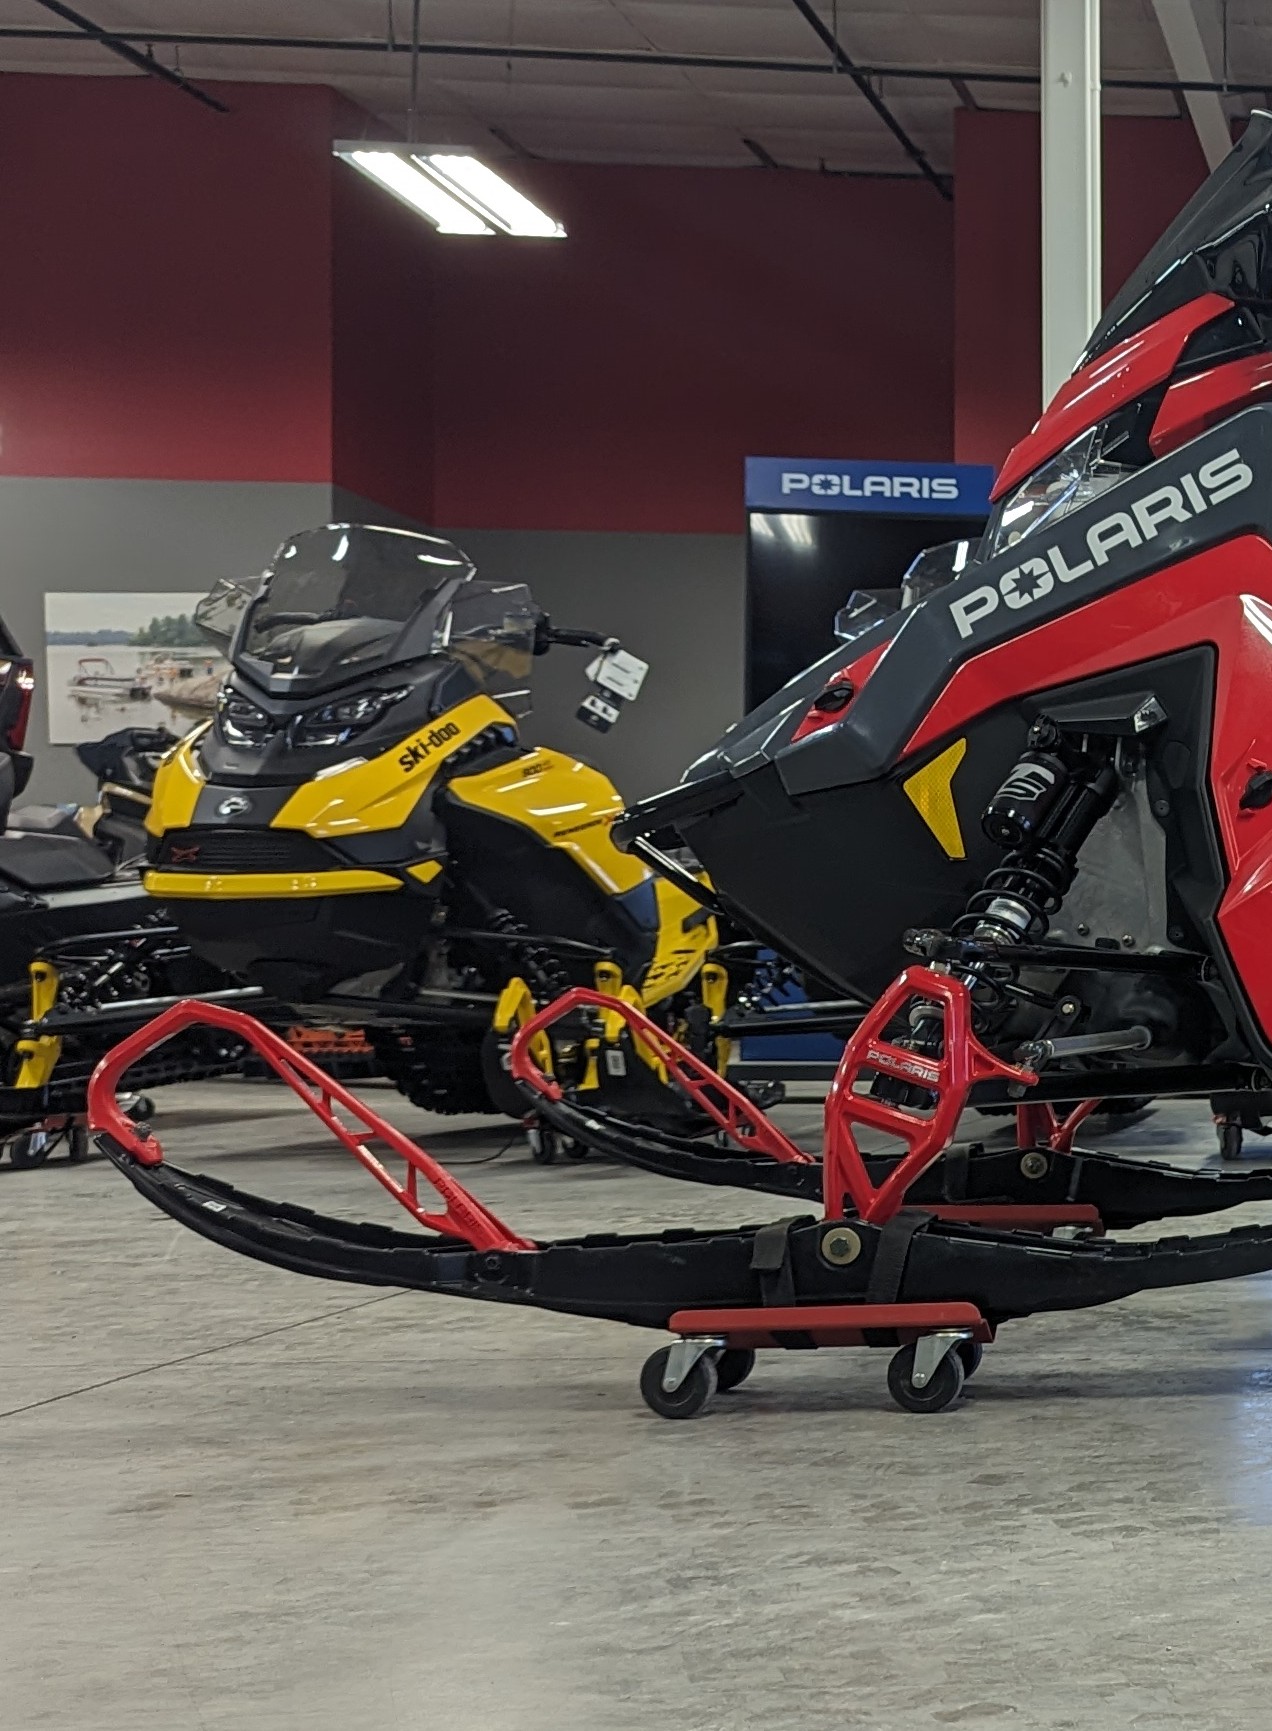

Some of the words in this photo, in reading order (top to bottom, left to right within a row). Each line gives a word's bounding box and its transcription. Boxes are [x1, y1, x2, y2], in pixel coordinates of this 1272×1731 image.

[781, 472, 959, 500] POLARIS
[949, 448, 1253, 640] POLARIS
[398, 721, 461, 773] ski-doo
[866, 1049, 941, 1083] POLARIS
